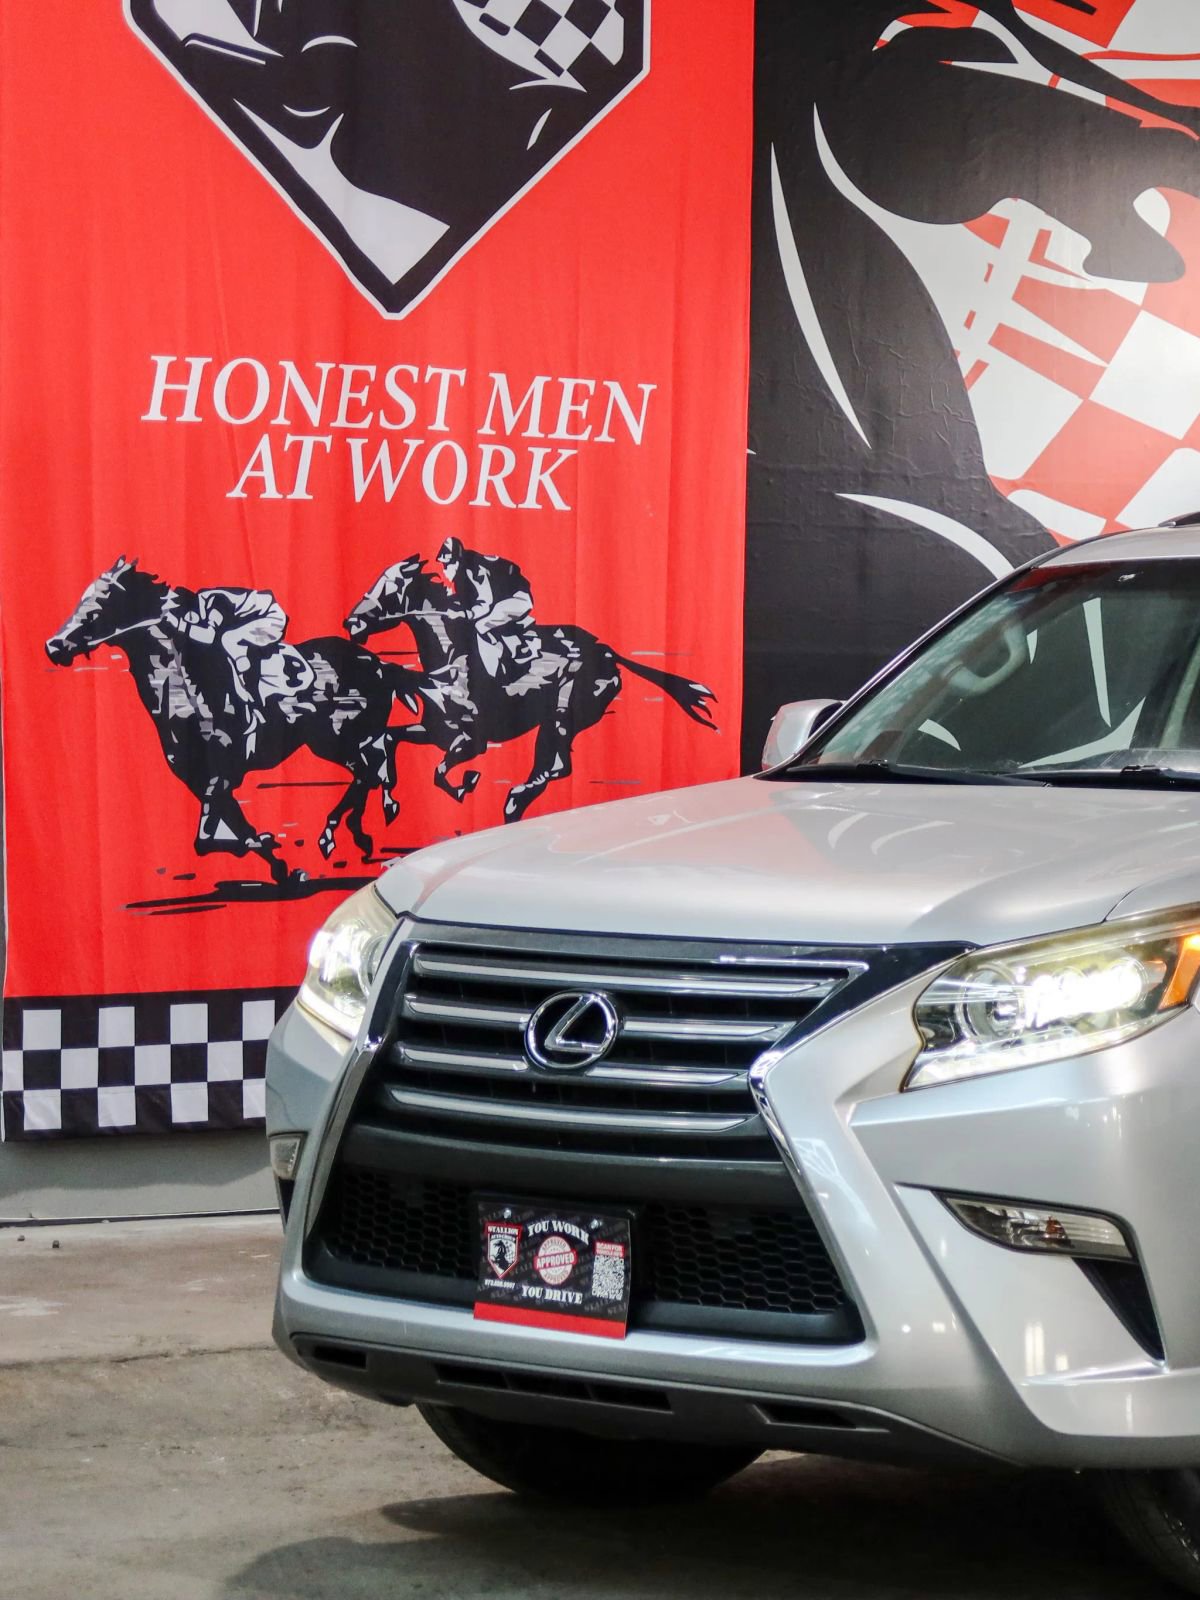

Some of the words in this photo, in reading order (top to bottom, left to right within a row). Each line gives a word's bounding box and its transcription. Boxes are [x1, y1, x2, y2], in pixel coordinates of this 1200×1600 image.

[141, 355, 466, 431] HONEST
[478, 372, 656, 445] MEN
[226, 433, 332, 499] AT
[347, 438, 577, 511] WORK
[527, 1221, 550, 1236] YOU
[552, 1220, 590, 1245] WORK
[536, 1253, 575, 1268] APPROVED
[521, 1284, 543, 1299] YOU
[544, 1287, 583, 1304] DRIVE
